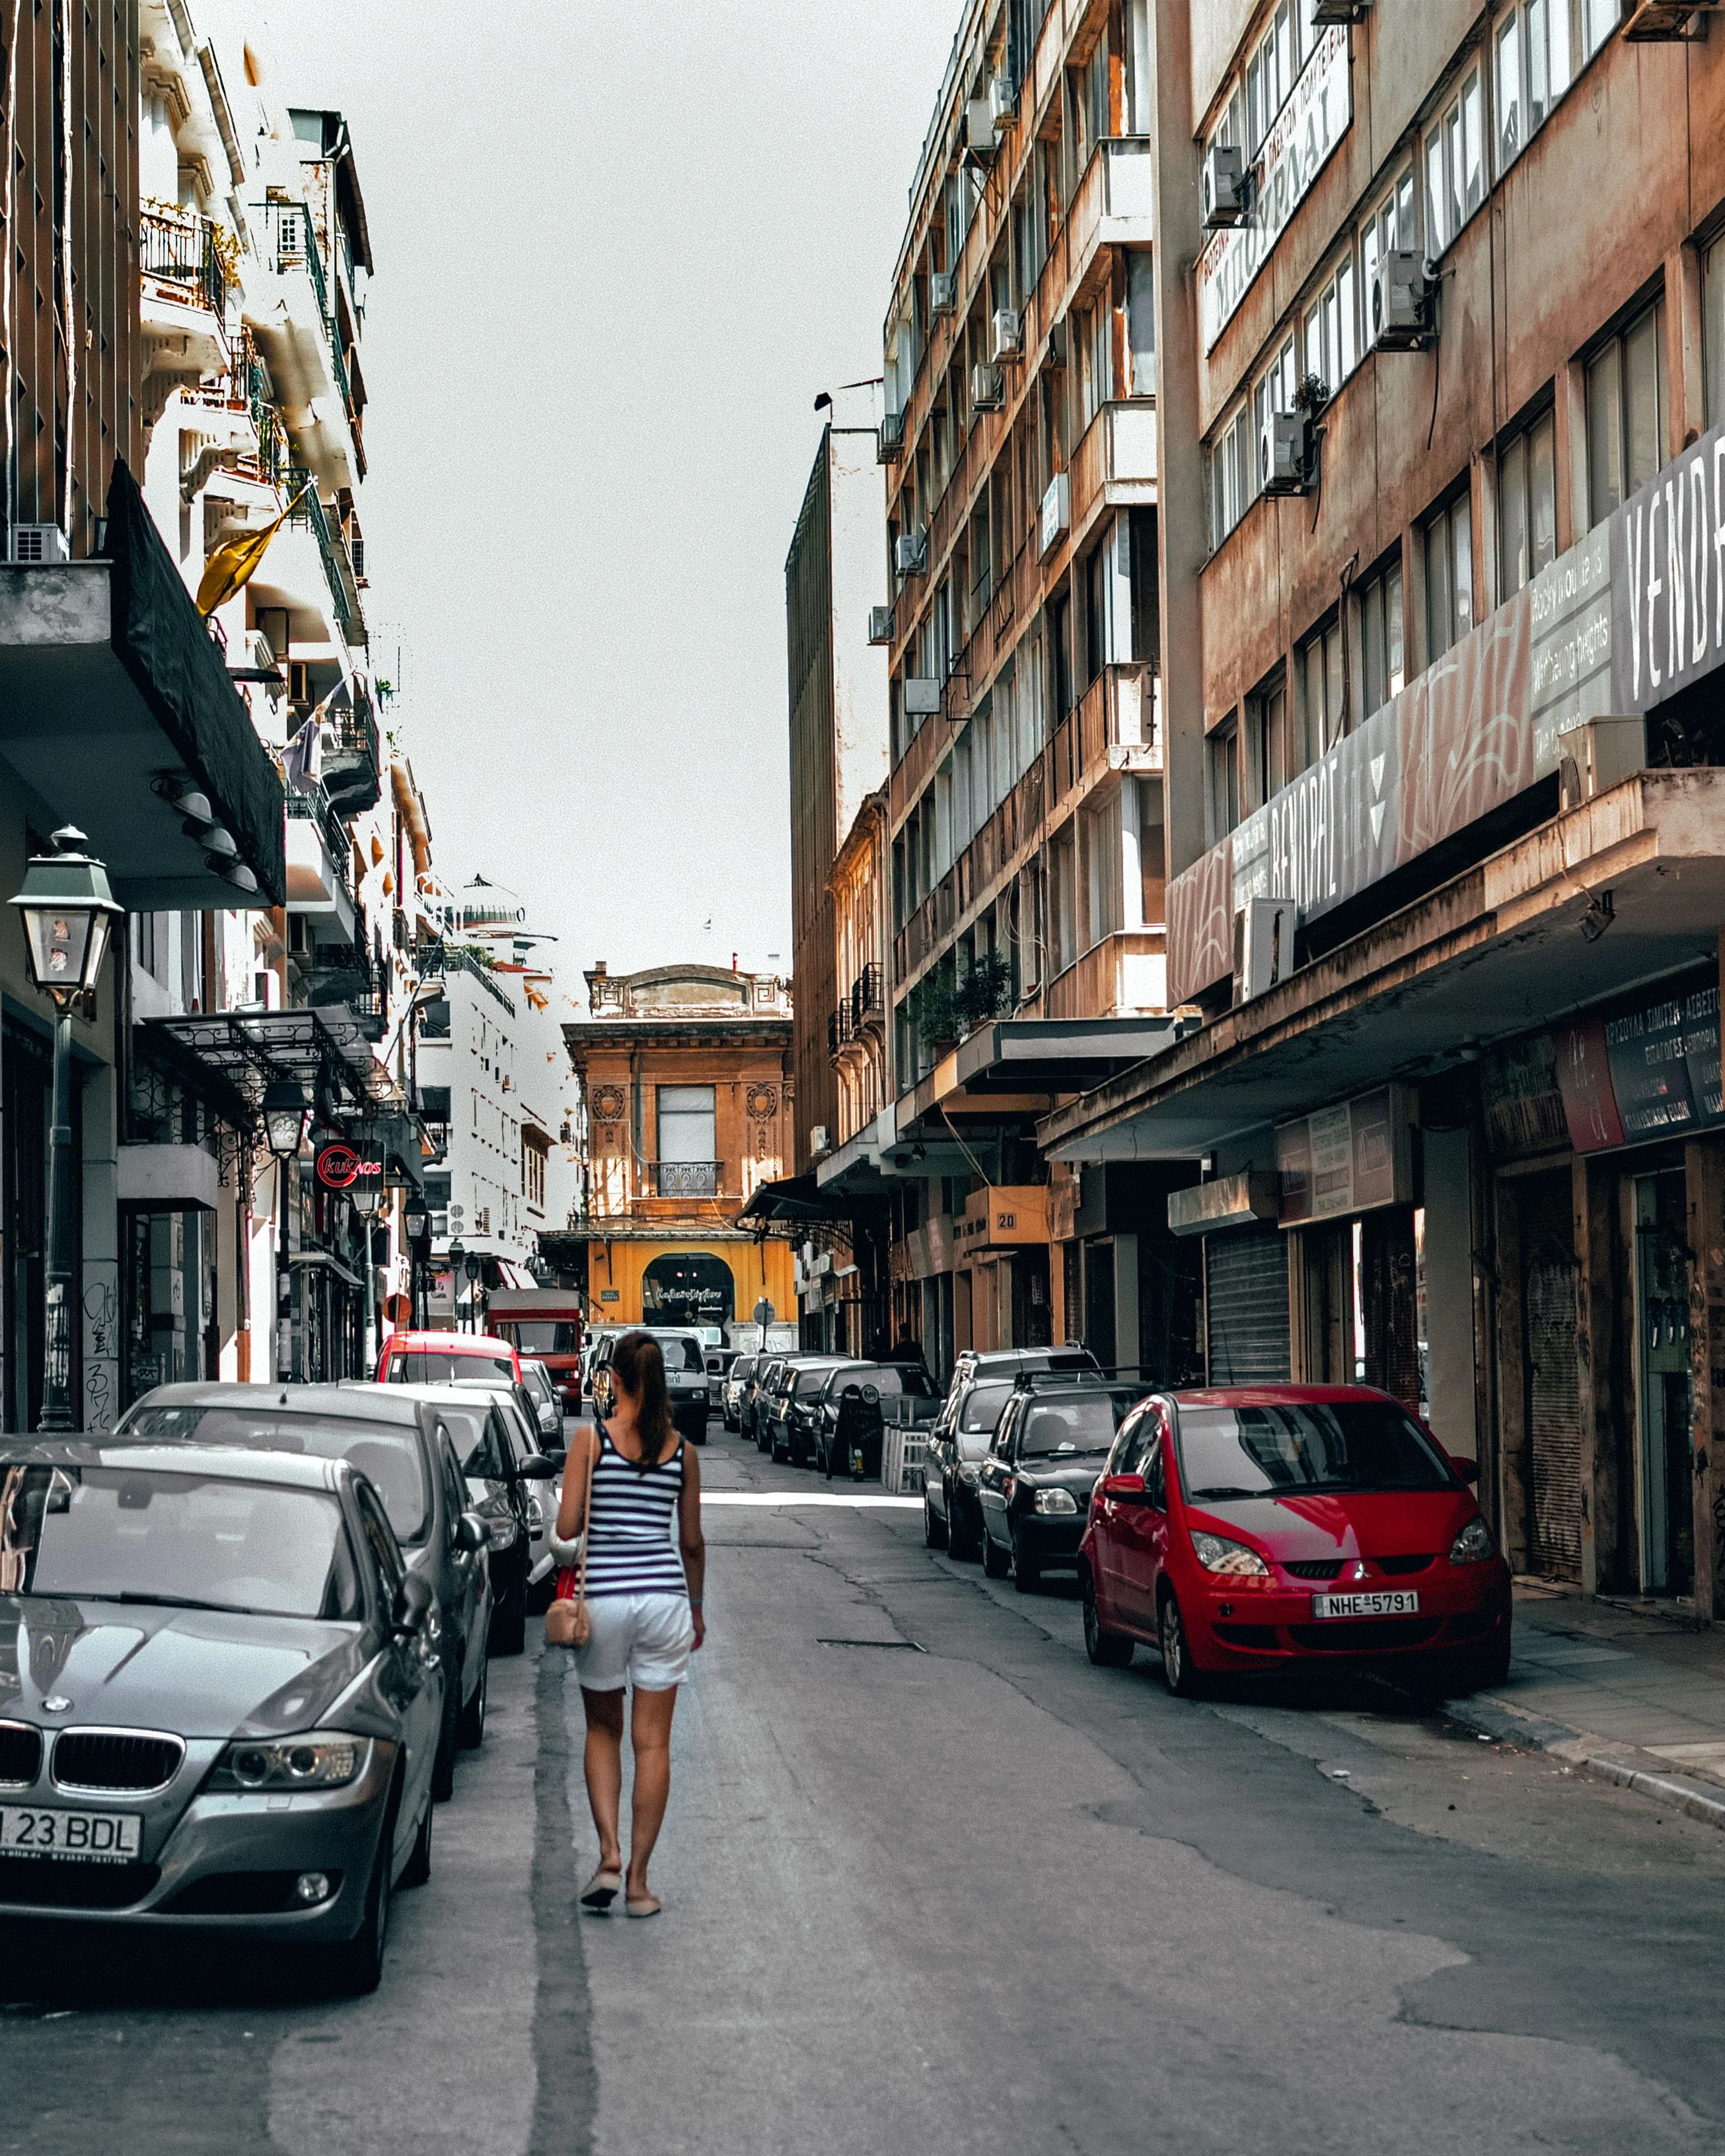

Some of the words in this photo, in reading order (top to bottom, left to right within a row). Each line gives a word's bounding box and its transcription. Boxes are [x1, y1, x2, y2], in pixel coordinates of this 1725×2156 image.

[999, 1215, 1014, 1228] 20
[16, 1813, 55, 1845] 23
[66, 1816, 134, 1851] BDL
